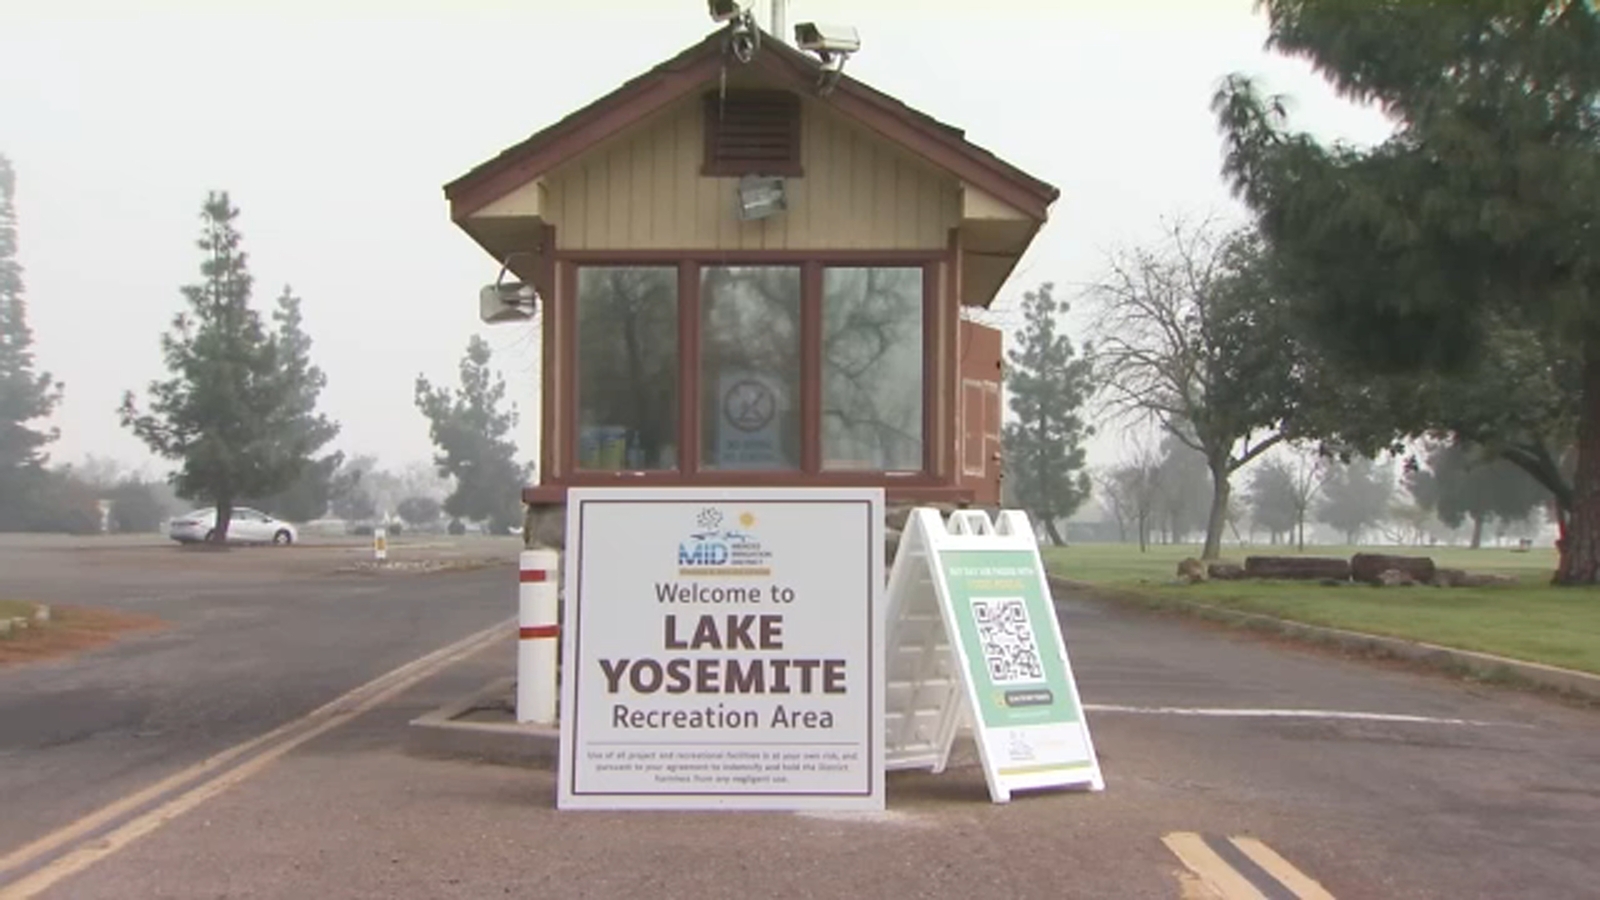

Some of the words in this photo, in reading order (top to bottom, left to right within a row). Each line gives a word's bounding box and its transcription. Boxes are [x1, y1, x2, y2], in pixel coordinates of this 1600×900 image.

[678, 542, 728, 565] MID
[656, 583, 761, 603] Welcome
[771, 585, 795, 603] to
[664, 615, 783, 650] LAKE
[598, 659, 846, 694] YOSEMITE
[612, 703, 758, 728] Recreation
[770, 706, 833, 728] Area
[587, 751, 603, 759] Use
[659, 751, 673, 759] and
[842, 751, 858, 759] and
[765, 763, 780, 771] and
